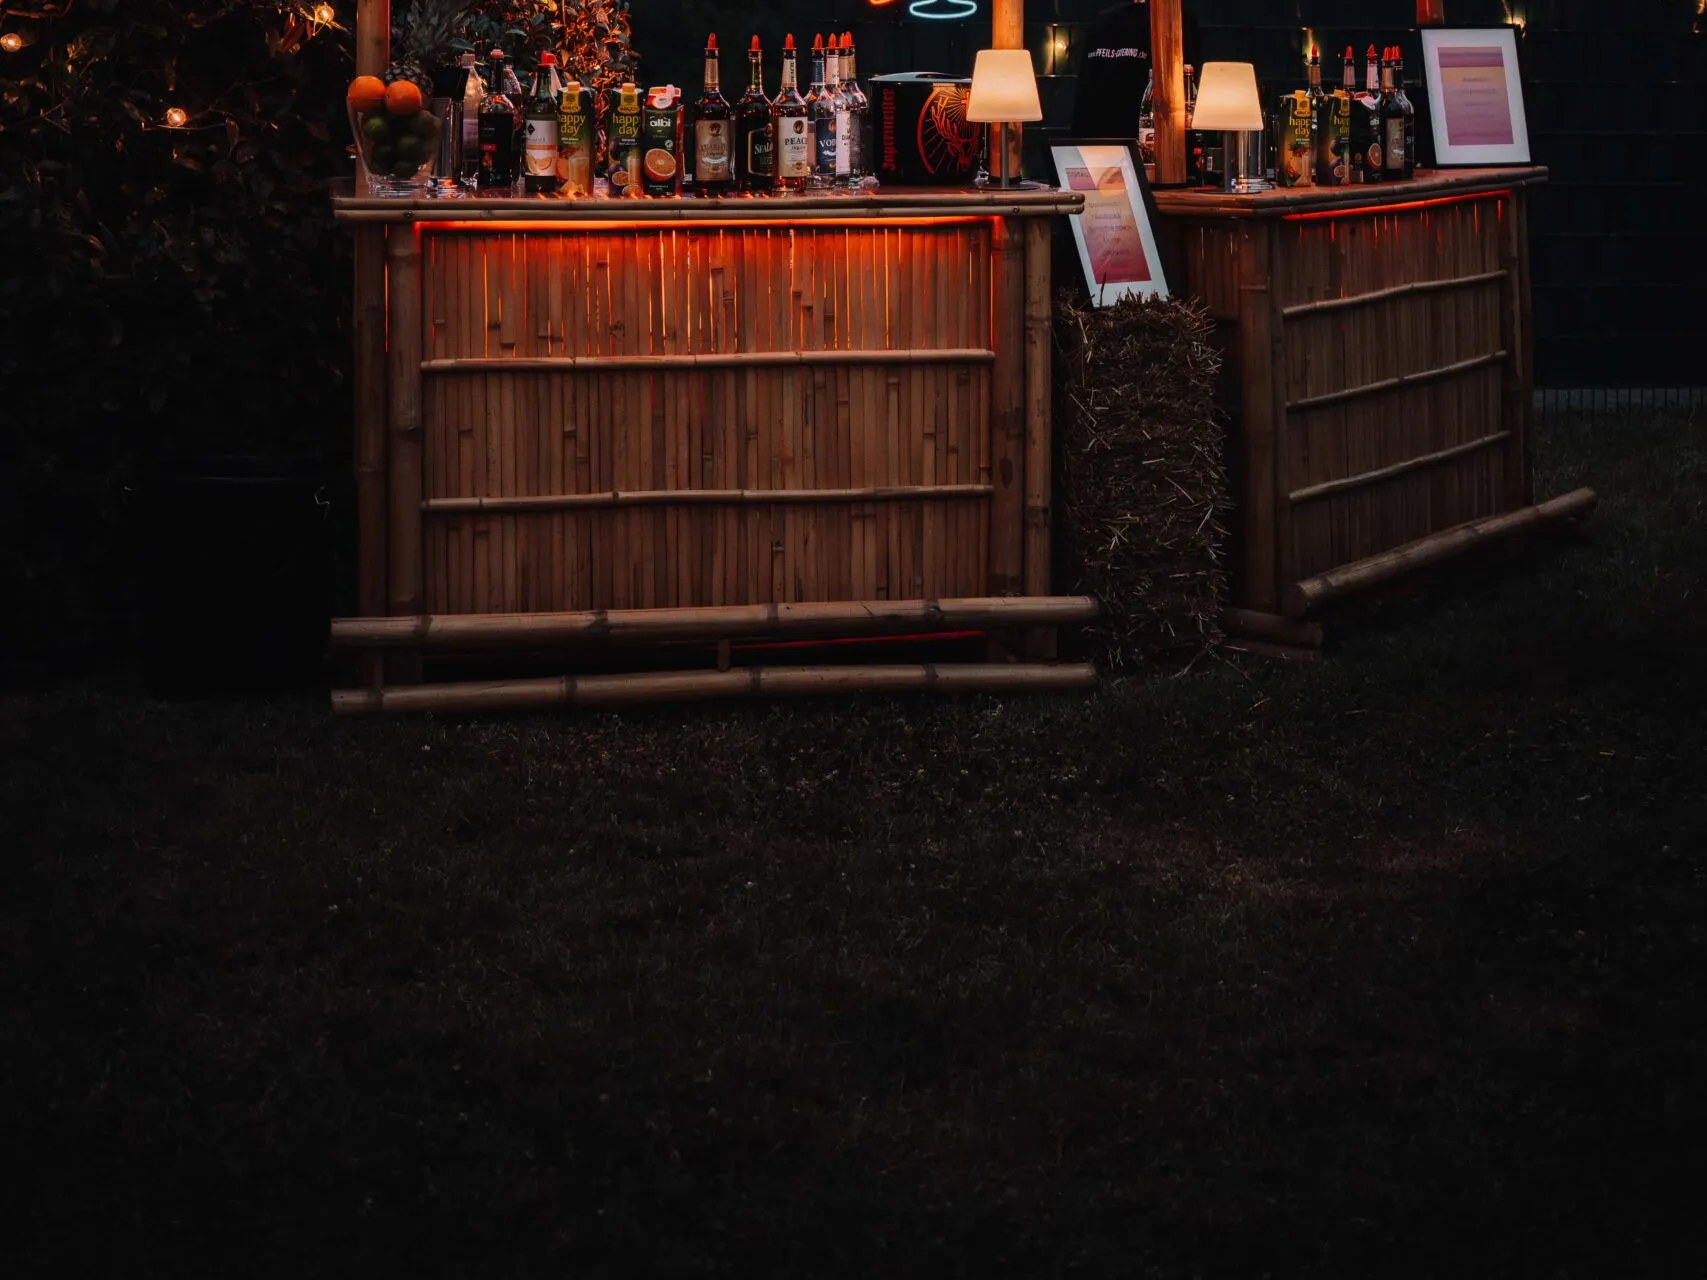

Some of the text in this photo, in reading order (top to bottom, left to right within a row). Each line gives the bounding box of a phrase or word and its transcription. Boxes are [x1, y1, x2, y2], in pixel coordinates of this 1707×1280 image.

[558, 114, 586, 126] appy
[649, 117, 671, 127] albi
[561, 123, 580, 136] day
[619, 125, 639, 137] day
